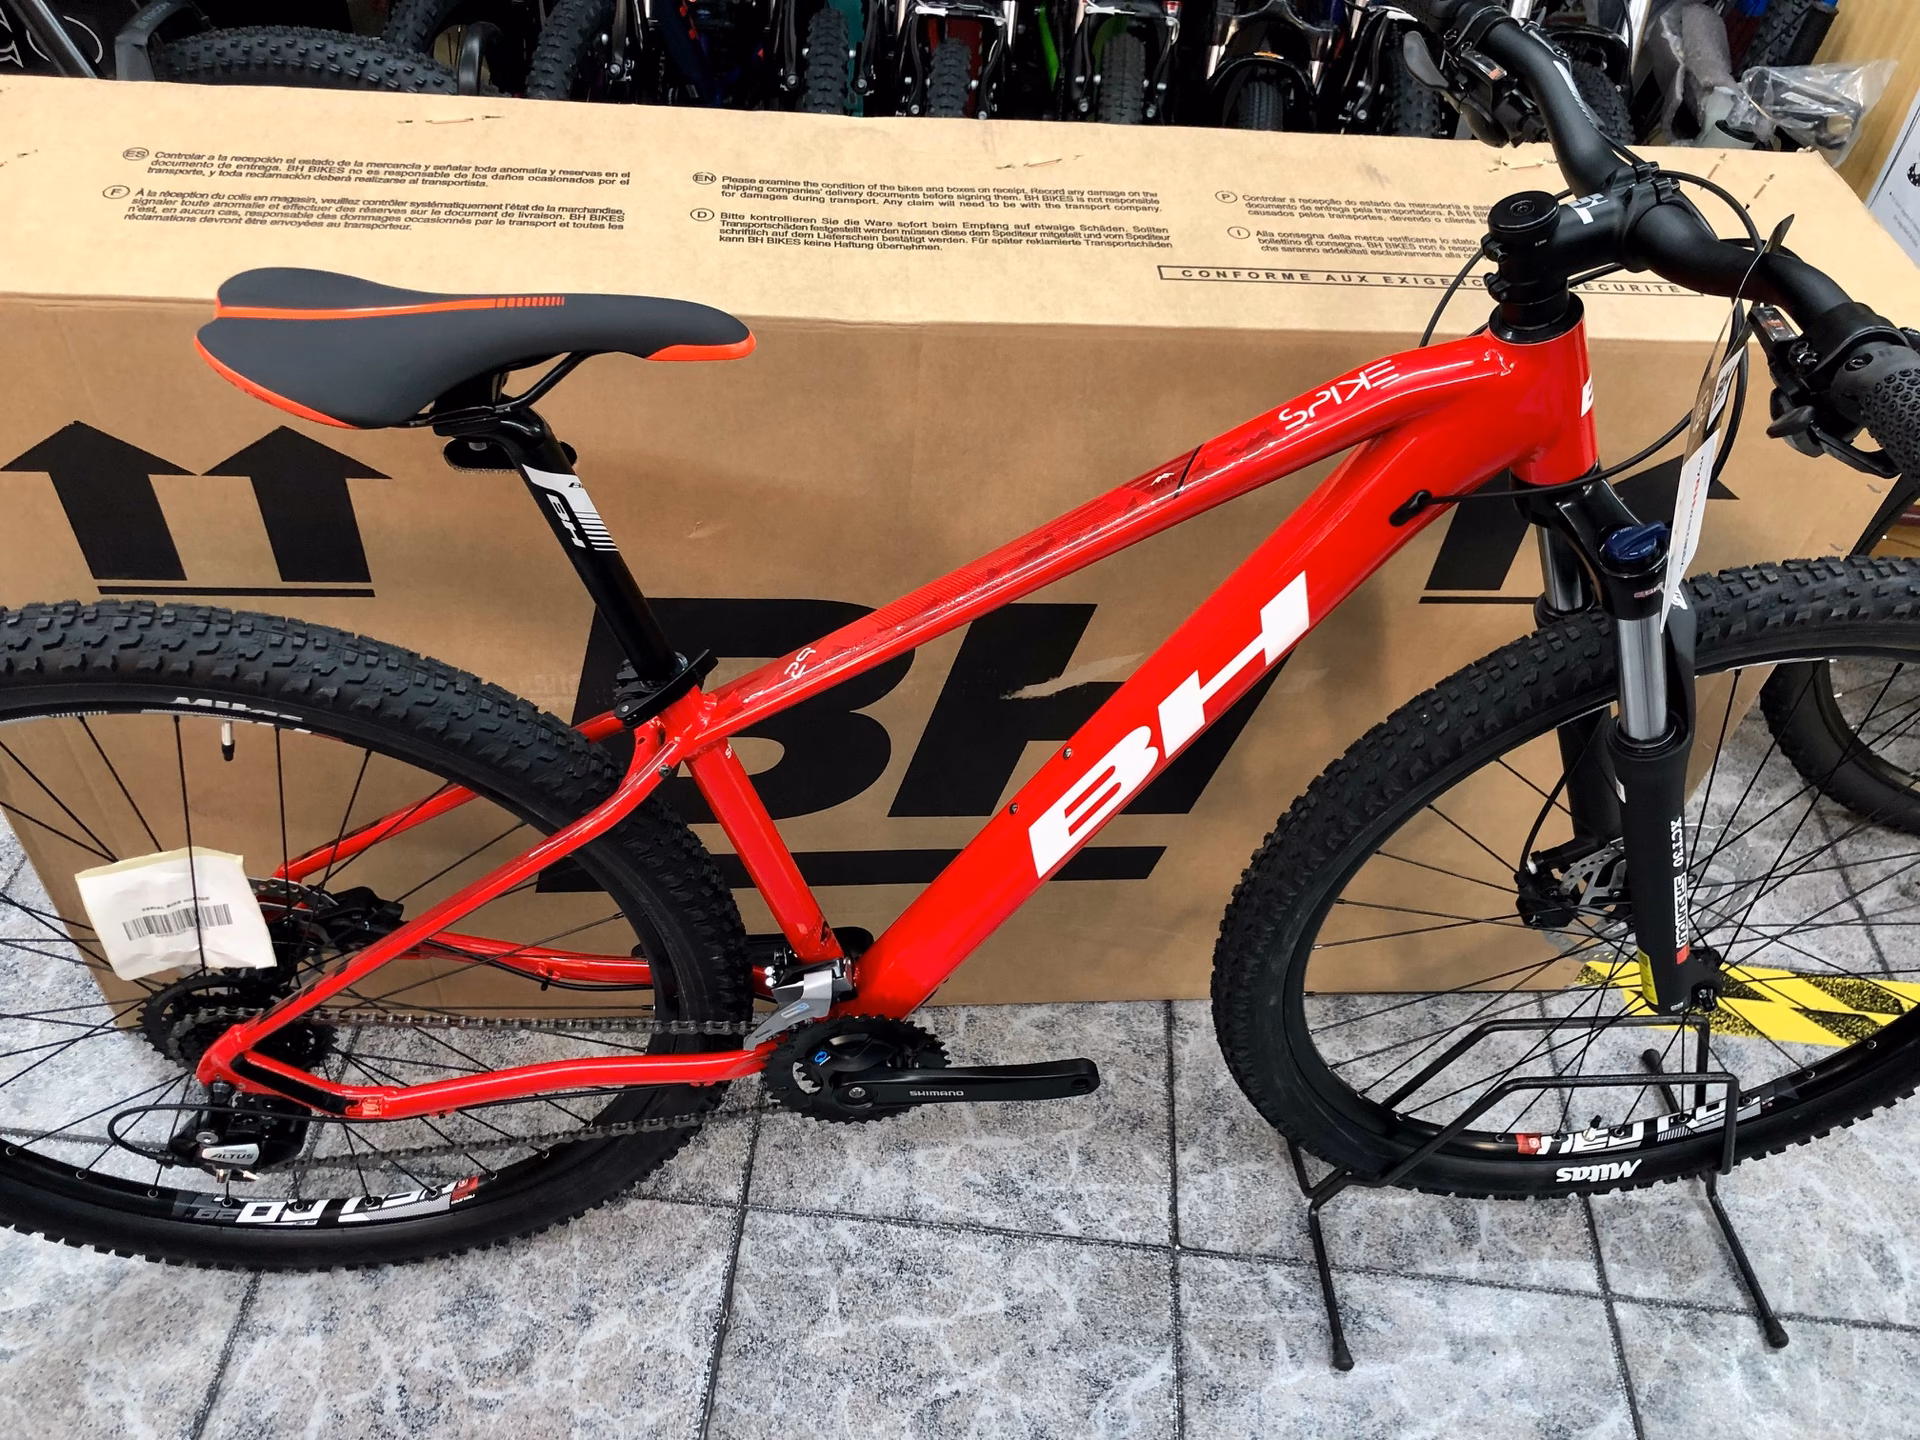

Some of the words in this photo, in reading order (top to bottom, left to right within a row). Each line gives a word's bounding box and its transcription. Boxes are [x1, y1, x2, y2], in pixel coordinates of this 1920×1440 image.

[125, 150, 146, 158] ES
[155, 151, 205, 160] Controlar
[228, 154, 284, 165] recepción
[296, 157, 336, 166] estado
[335, 159, 352, 167] de
[364, 160, 423, 169] mercancía
[431, 163, 472, 171] señalar
[498, 166, 548, 174] anomalía
[148, 166, 203, 177] transporte,
[217, 169, 243, 177] toda
[244, 170, 312, 180] reclamación
[312, 173, 352, 182] deberá
[353, 175, 407, 184] realizarse
[419, 178, 488, 189] transportista.
[151, 159, 214, 168] documento
[234, 162, 280, 172] entrega.
[284, 164, 306, 172] BH
[306, 165, 346, 174] BIKES
[382, 169, 451, 180] responsable
[452, 171, 469, 179] de
[489, 173, 525, 181] daños
[526, 174, 595, 184] ocasionados
[618, 178, 633, 186] el
[695, 174, 715, 183] EN
[721, 182, 763, 193] shipping
[766, 185, 822, 196] companies'
[825, 188, 863, 197] delivery
[866, 189, 919, 198] documents
[922, 191, 953, 199] before
[956, 192, 991, 201] signing
[1105, 196, 1160, 206] responsible
[722, 175, 756, 183] Please
[758, 177, 800, 186] examine
[803, 179, 818, 187] the
[821, 180, 865, 189] condition
[897, 183, 923, 191] bikes
[926, 184, 944, 192] and
[992, 186, 1028, 195] receipt.
[1029, 187, 1065, 195] Record
[1067, 189, 1084, 197] any
[1087, 188, 1125, 198] damage
[721, 189, 735, 197] for
[739, 190, 788, 201] damages
[792, 193, 825, 203] during
[829, 195, 879, 205] transport.
[883, 197, 903, 206] Any
[907, 198, 934, 206] claim
[959, 199, 984, 207] need
[1064, 202, 1110, 211] transport
[1114, 205, 1162, 213] company.
[124, 212, 197, 222] réclamations
[198, 215, 243, 224] devront
[243, 217, 268, 225] être
[268, 218, 325, 228] envoyées
[342, 221, 412, 231] transporteur.
[721, 211, 745, 219] Bitte
[750, 213, 816, 223] kontrollieren
[821, 216, 838, 224] Sie
[843, 217, 859, 225] die
[864, 218, 892, 226] Ware
[897, 219, 927, 227] sofort
[931, 220, 957, 228] beim
[962, 221, 1009, 230] Empfang
[1034, 223, 1075, 232] etwaige
[1079, 224, 1128, 232] Schäden.
[1132, 225, 1169, 233] Sollten
[719, 226, 768, 235] schriftlich
[791, 230, 814, 238] dem
[817, 231, 878, 240] Lieferschein
[881, 234, 924, 243] bestätigt
[928, 235, 968, 243] werden.
[991, 236, 1022, 245] später
[1025, 237, 1081, 245] reklamierte
[1085, 238, 1173, 249] Transportschäden
[1181, 269, 1312, 281] CONFORME
[1325, 273, 1370, 284] AUX
[1278, 359, 1400, 431] SPIKE
[546, 493, 586, 549] BH
[555, 598, 1305, 824] BH
[1028, 569, 1310, 879] BH
[1670, 816, 1684, 868] XCT30
[1556, 1158, 1643, 1183] Mitas
